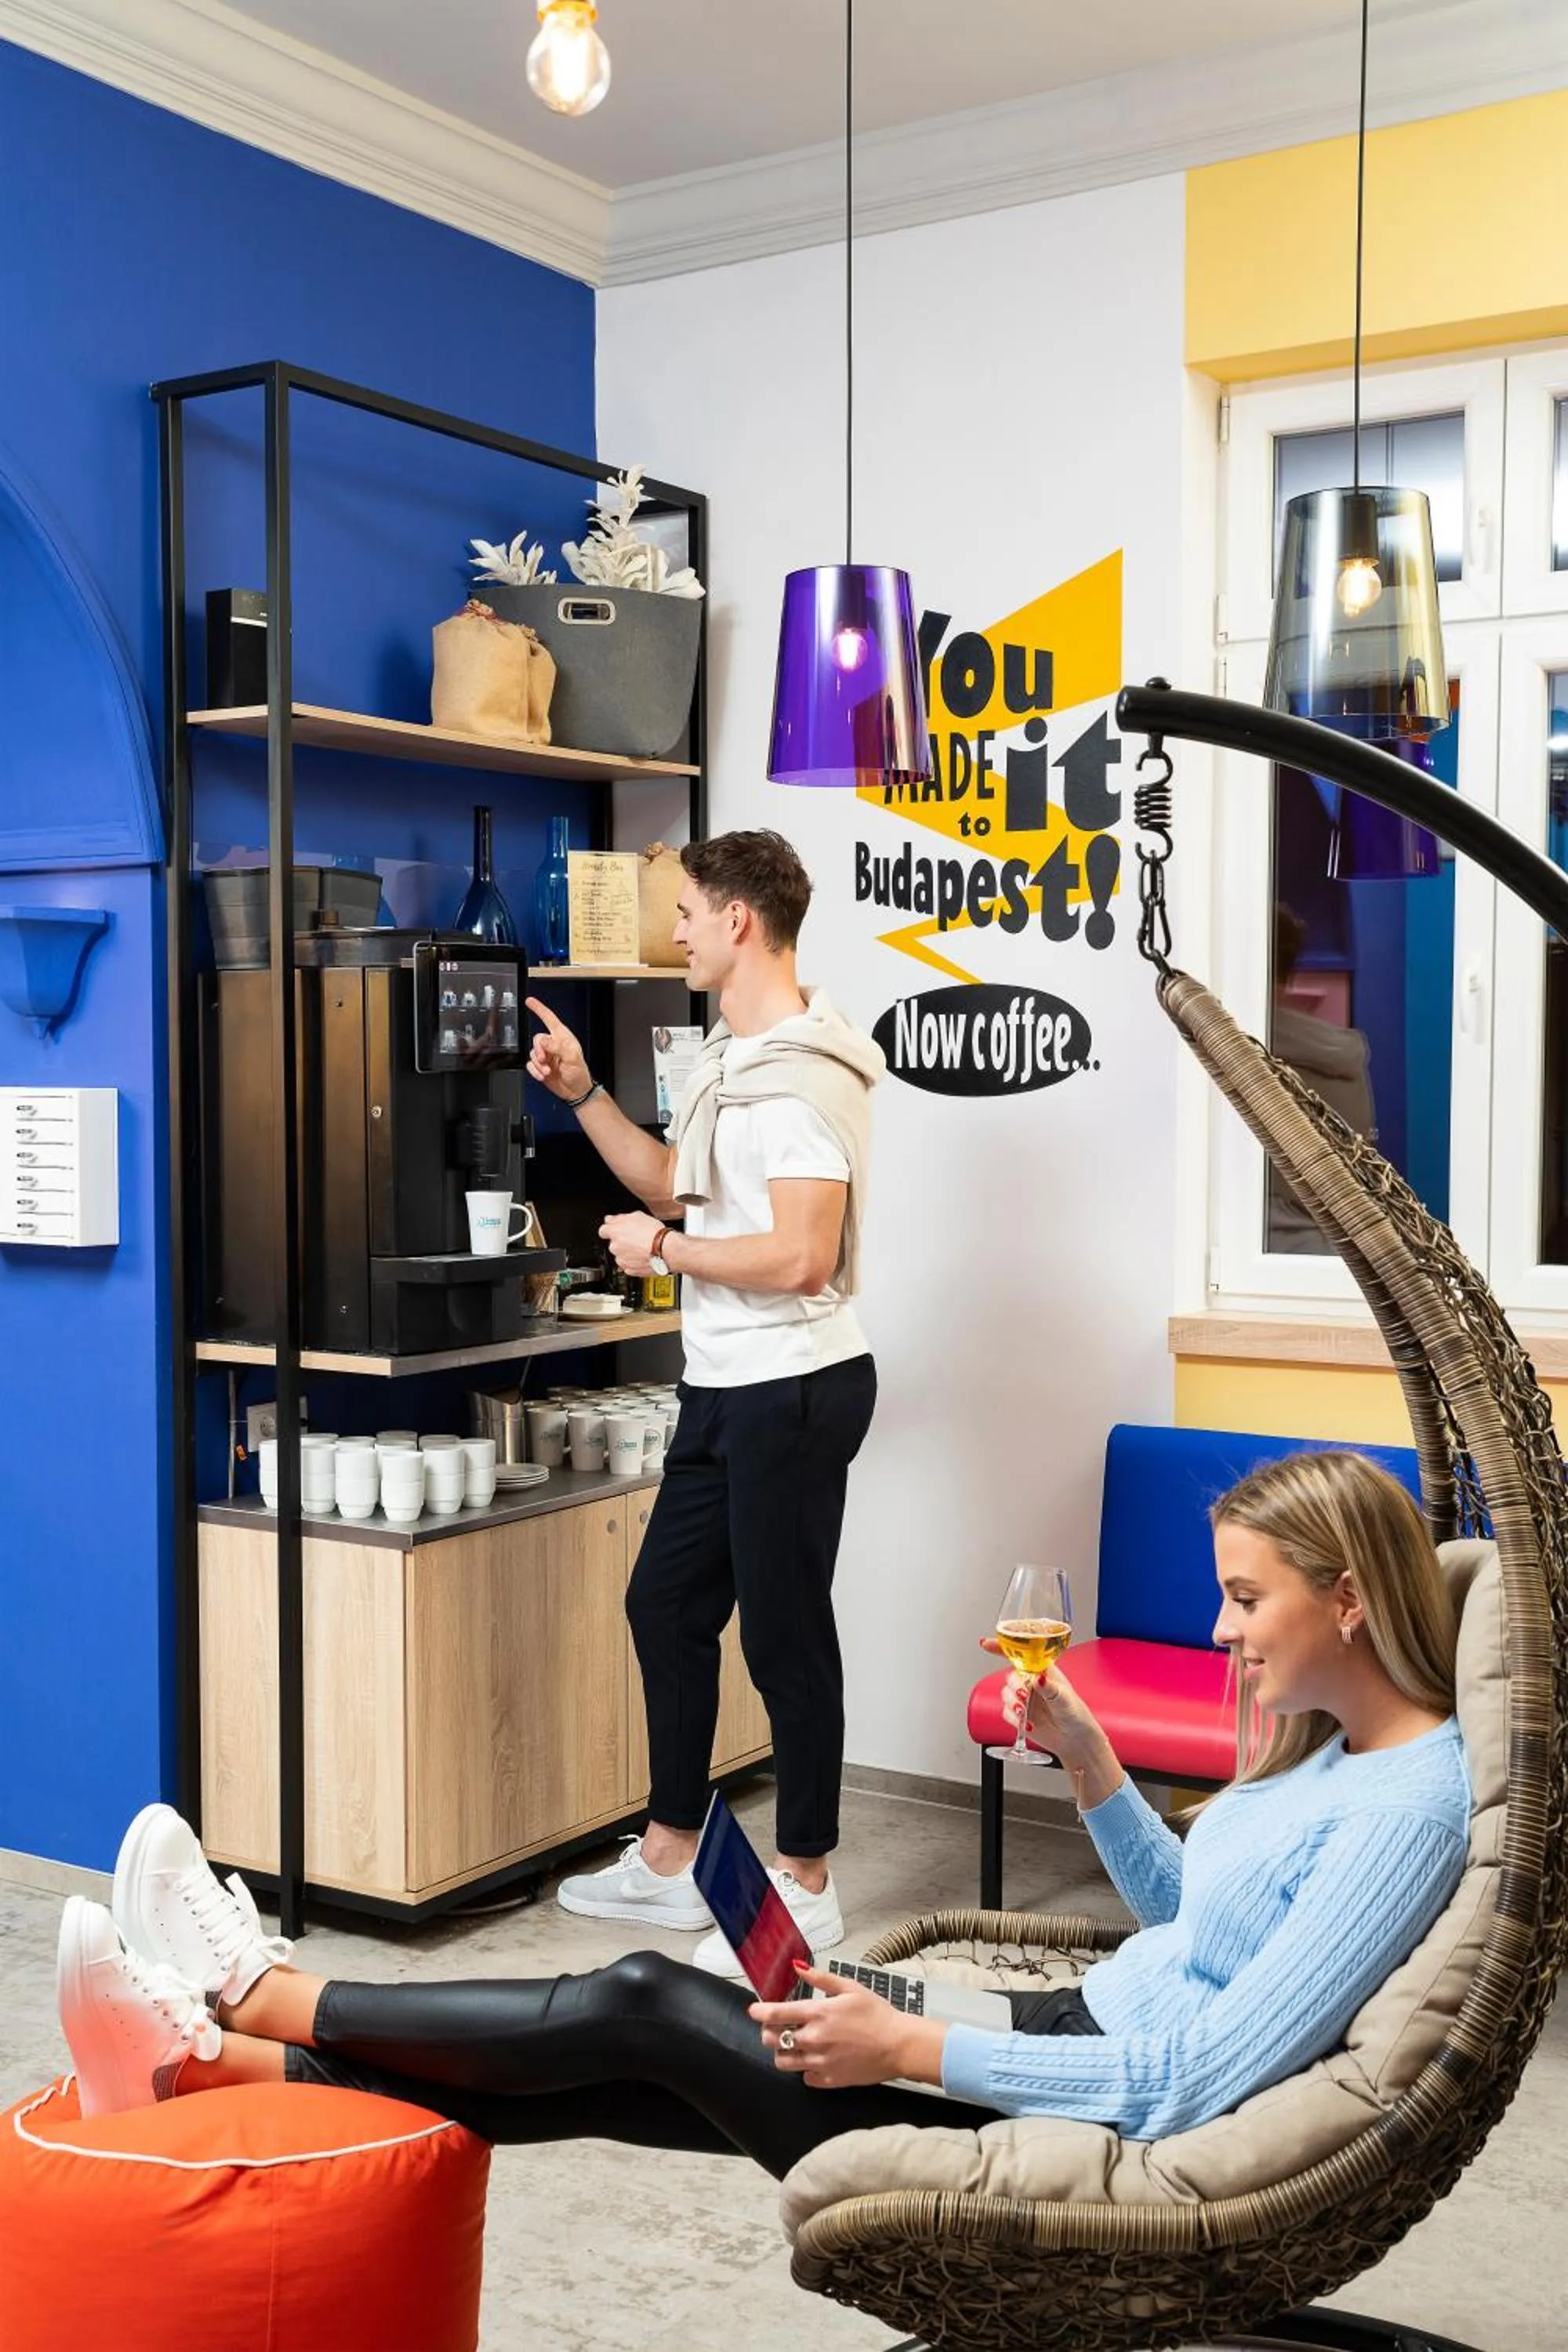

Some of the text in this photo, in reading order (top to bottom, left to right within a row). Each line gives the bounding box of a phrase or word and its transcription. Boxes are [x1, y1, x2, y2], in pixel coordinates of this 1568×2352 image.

[1005, 710, 1122, 833] it
[957, 811, 991, 837] to
[855, 833, 1120, 950] Budapest!
[895, 999, 967, 1069] Now
